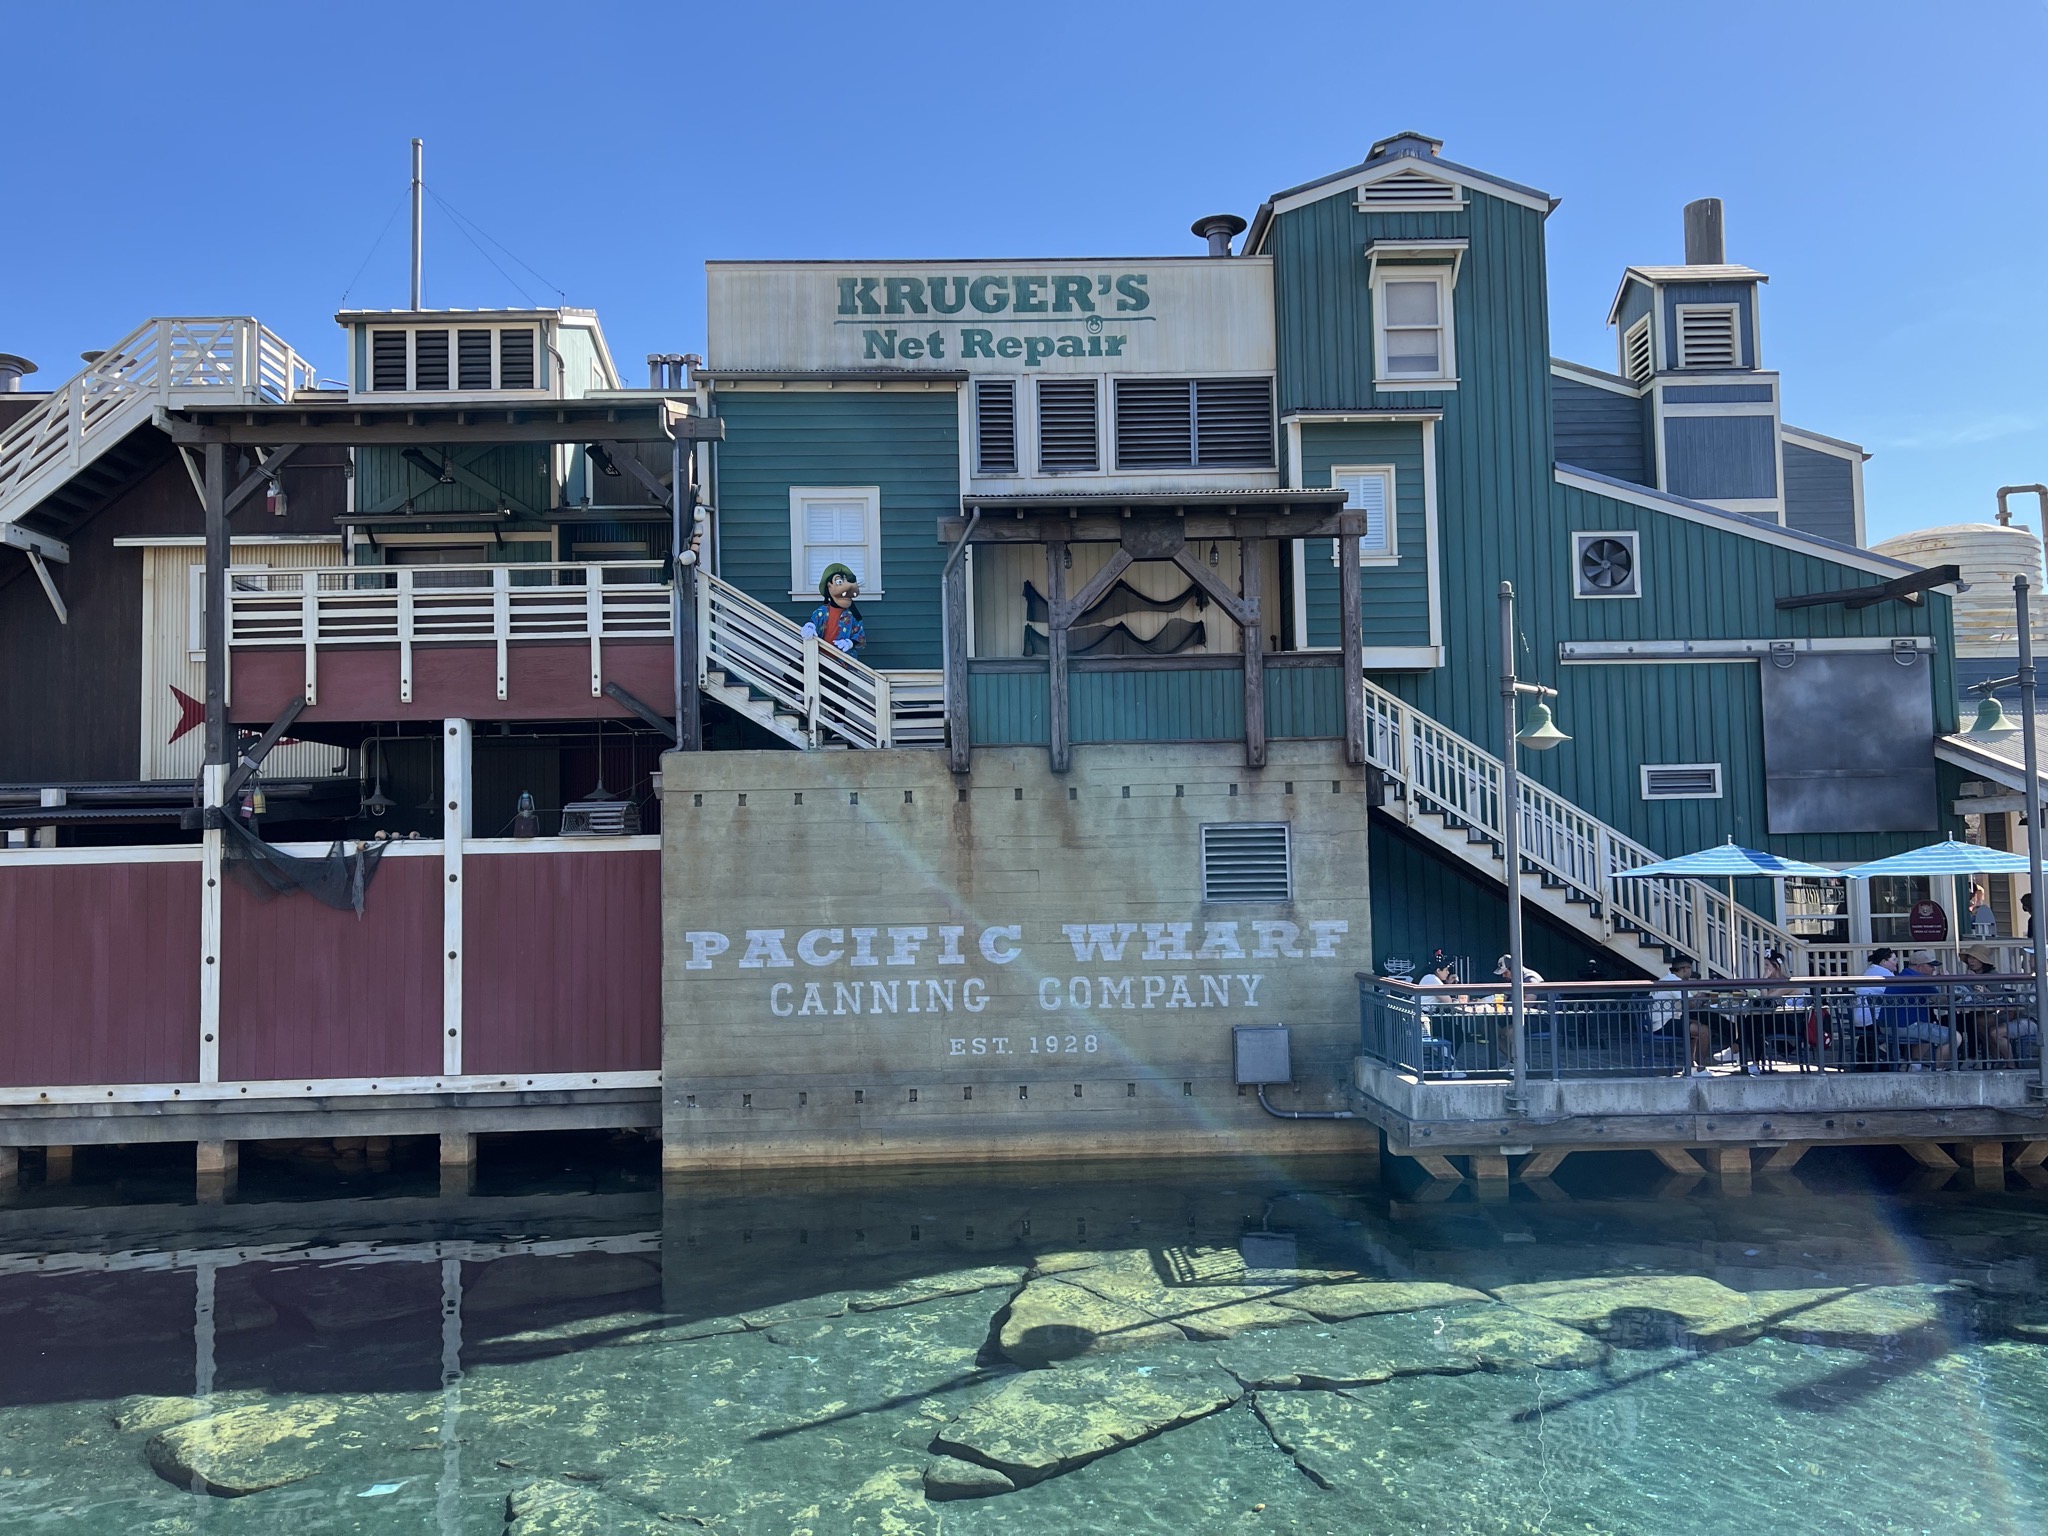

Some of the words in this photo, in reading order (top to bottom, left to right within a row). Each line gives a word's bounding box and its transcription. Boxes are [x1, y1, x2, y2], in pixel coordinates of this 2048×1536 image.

[837, 274, 1150, 315] KRUGER'S
[863, 329, 945, 360] Net
[960, 328, 1127, 367] Repair
[685, 925, 1022, 970] PACIFIC
[1062, 920, 1349, 962] WHARF
[770, 977, 990, 1017] CANNING
[1038, 974, 1264, 1011] COMPANY
[950, 1037, 1013, 1056] EST.
[1029, 1034, 1098, 1054] 1928
